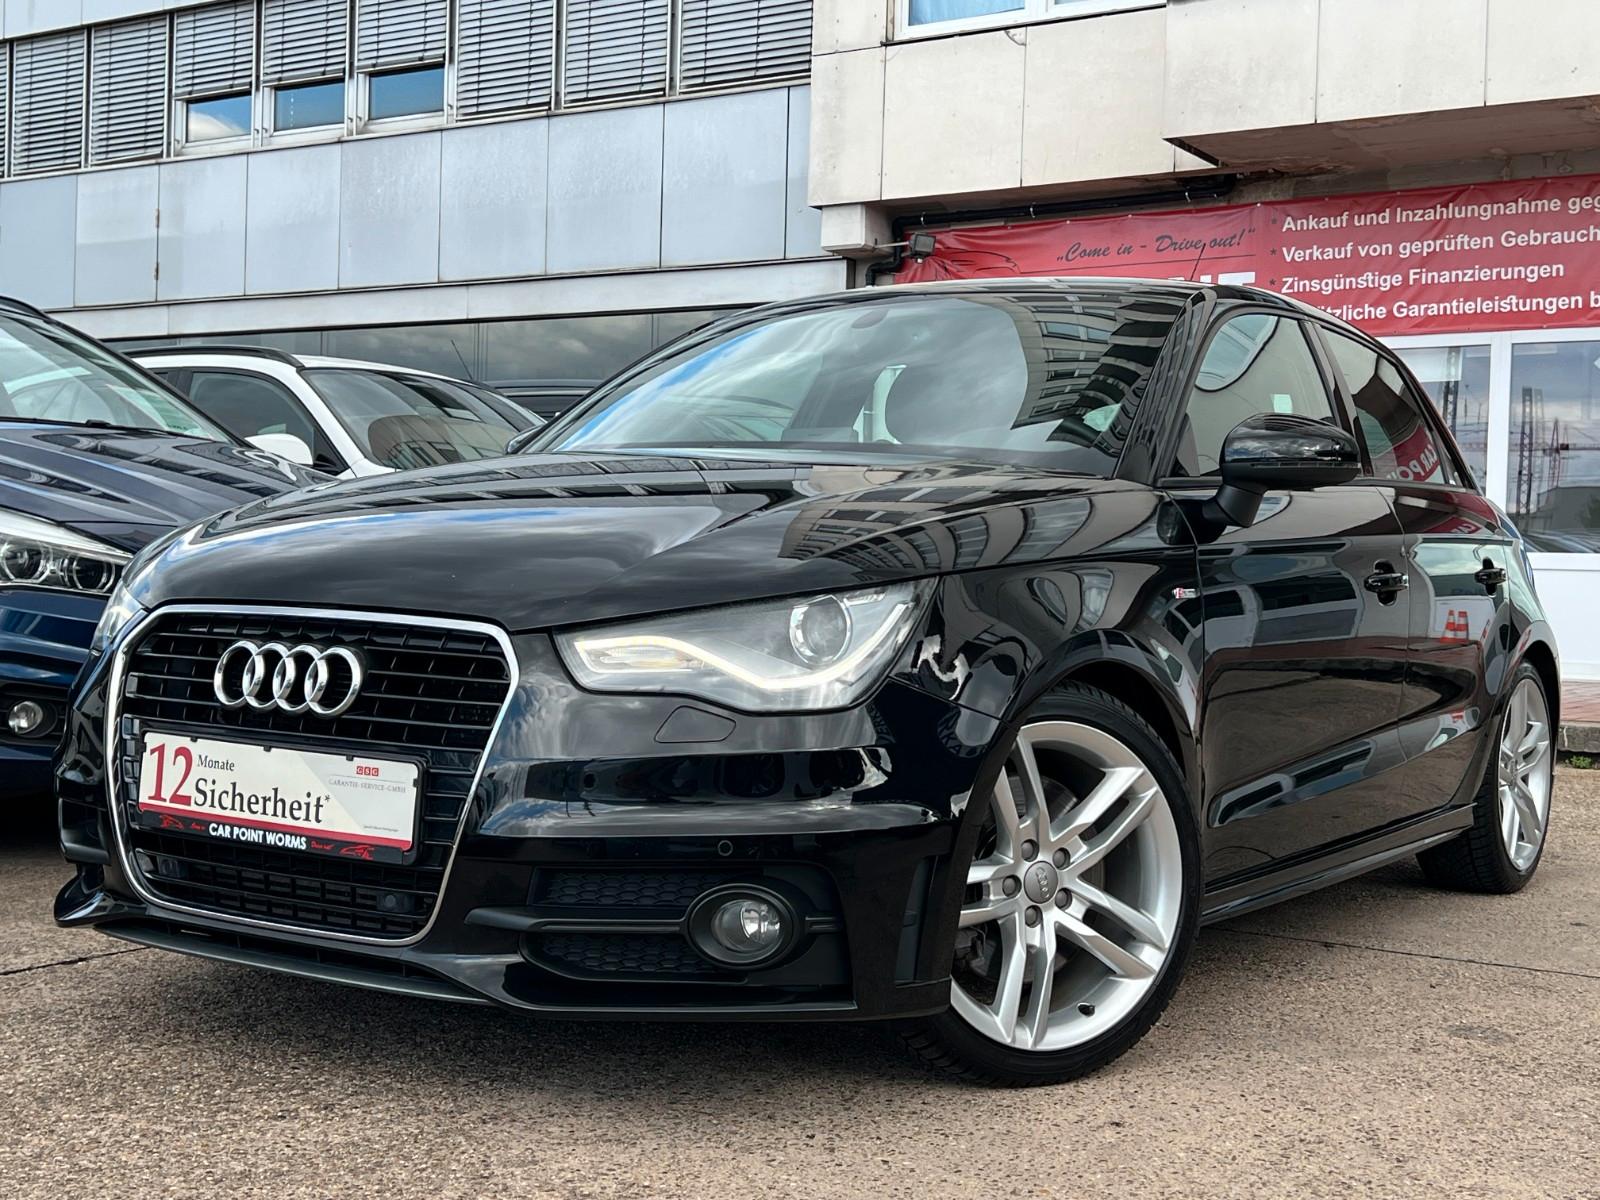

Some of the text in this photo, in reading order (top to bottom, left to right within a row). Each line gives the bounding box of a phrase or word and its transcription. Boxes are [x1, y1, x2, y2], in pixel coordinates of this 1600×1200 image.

[1281, 211, 1349, 232] Ankauf
[1353, 208, 1390, 227] und
[1396, 198, 1561, 223] Inzahlungnahme
[1116, 242, 1135, 256] in
[1155, 234, 1204, 253] Drive
[1281, 225, 1600, 262] Verkauf von geprüften Gebrauch
[1281, 272, 1403, 295] Zinsgünstige
[1408, 263, 1564, 286] Finanzierungen
[1392, 295, 1583, 317] Garantieleistungen
[148, 743, 193, 807] 12
[197, 754, 235, 772] Monate
[208, 823, 231, 838] CAR
[233, 827, 264, 843] POINT
[265, 831, 307, 850] WORMS
